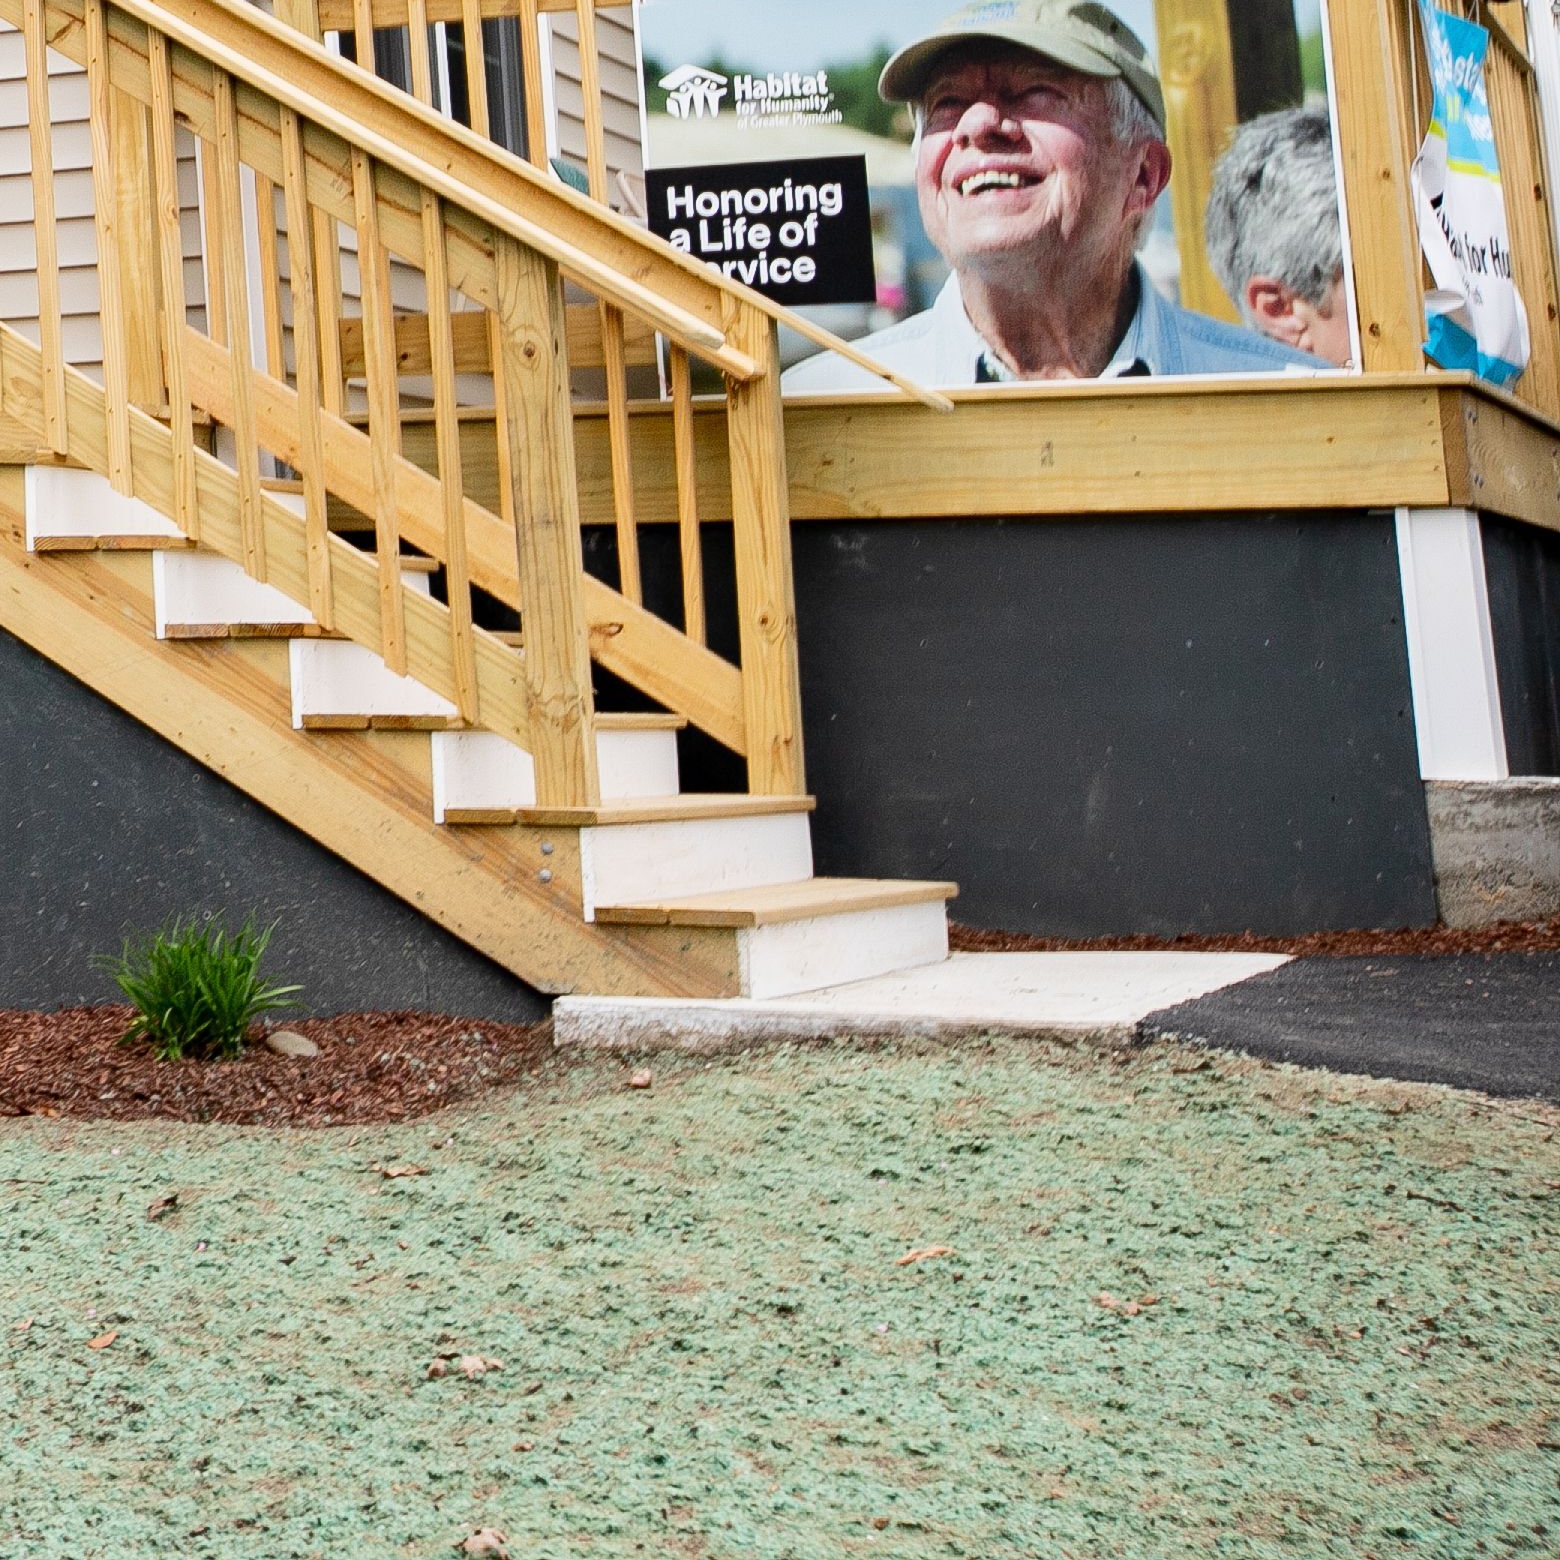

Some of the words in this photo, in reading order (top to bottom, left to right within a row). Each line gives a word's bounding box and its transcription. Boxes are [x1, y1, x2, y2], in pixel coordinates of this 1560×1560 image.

[733, 70, 829, 101] Habitat
[735, 100, 757, 116] for
[760, 93, 829, 115] Humanity
[792, 108, 843, 127] Plymouth
[666, 178, 843, 220] Honoring
[669, 228, 691, 253] a
[699, 217, 772, 253] Life
[779, 212, 818, 248] of
